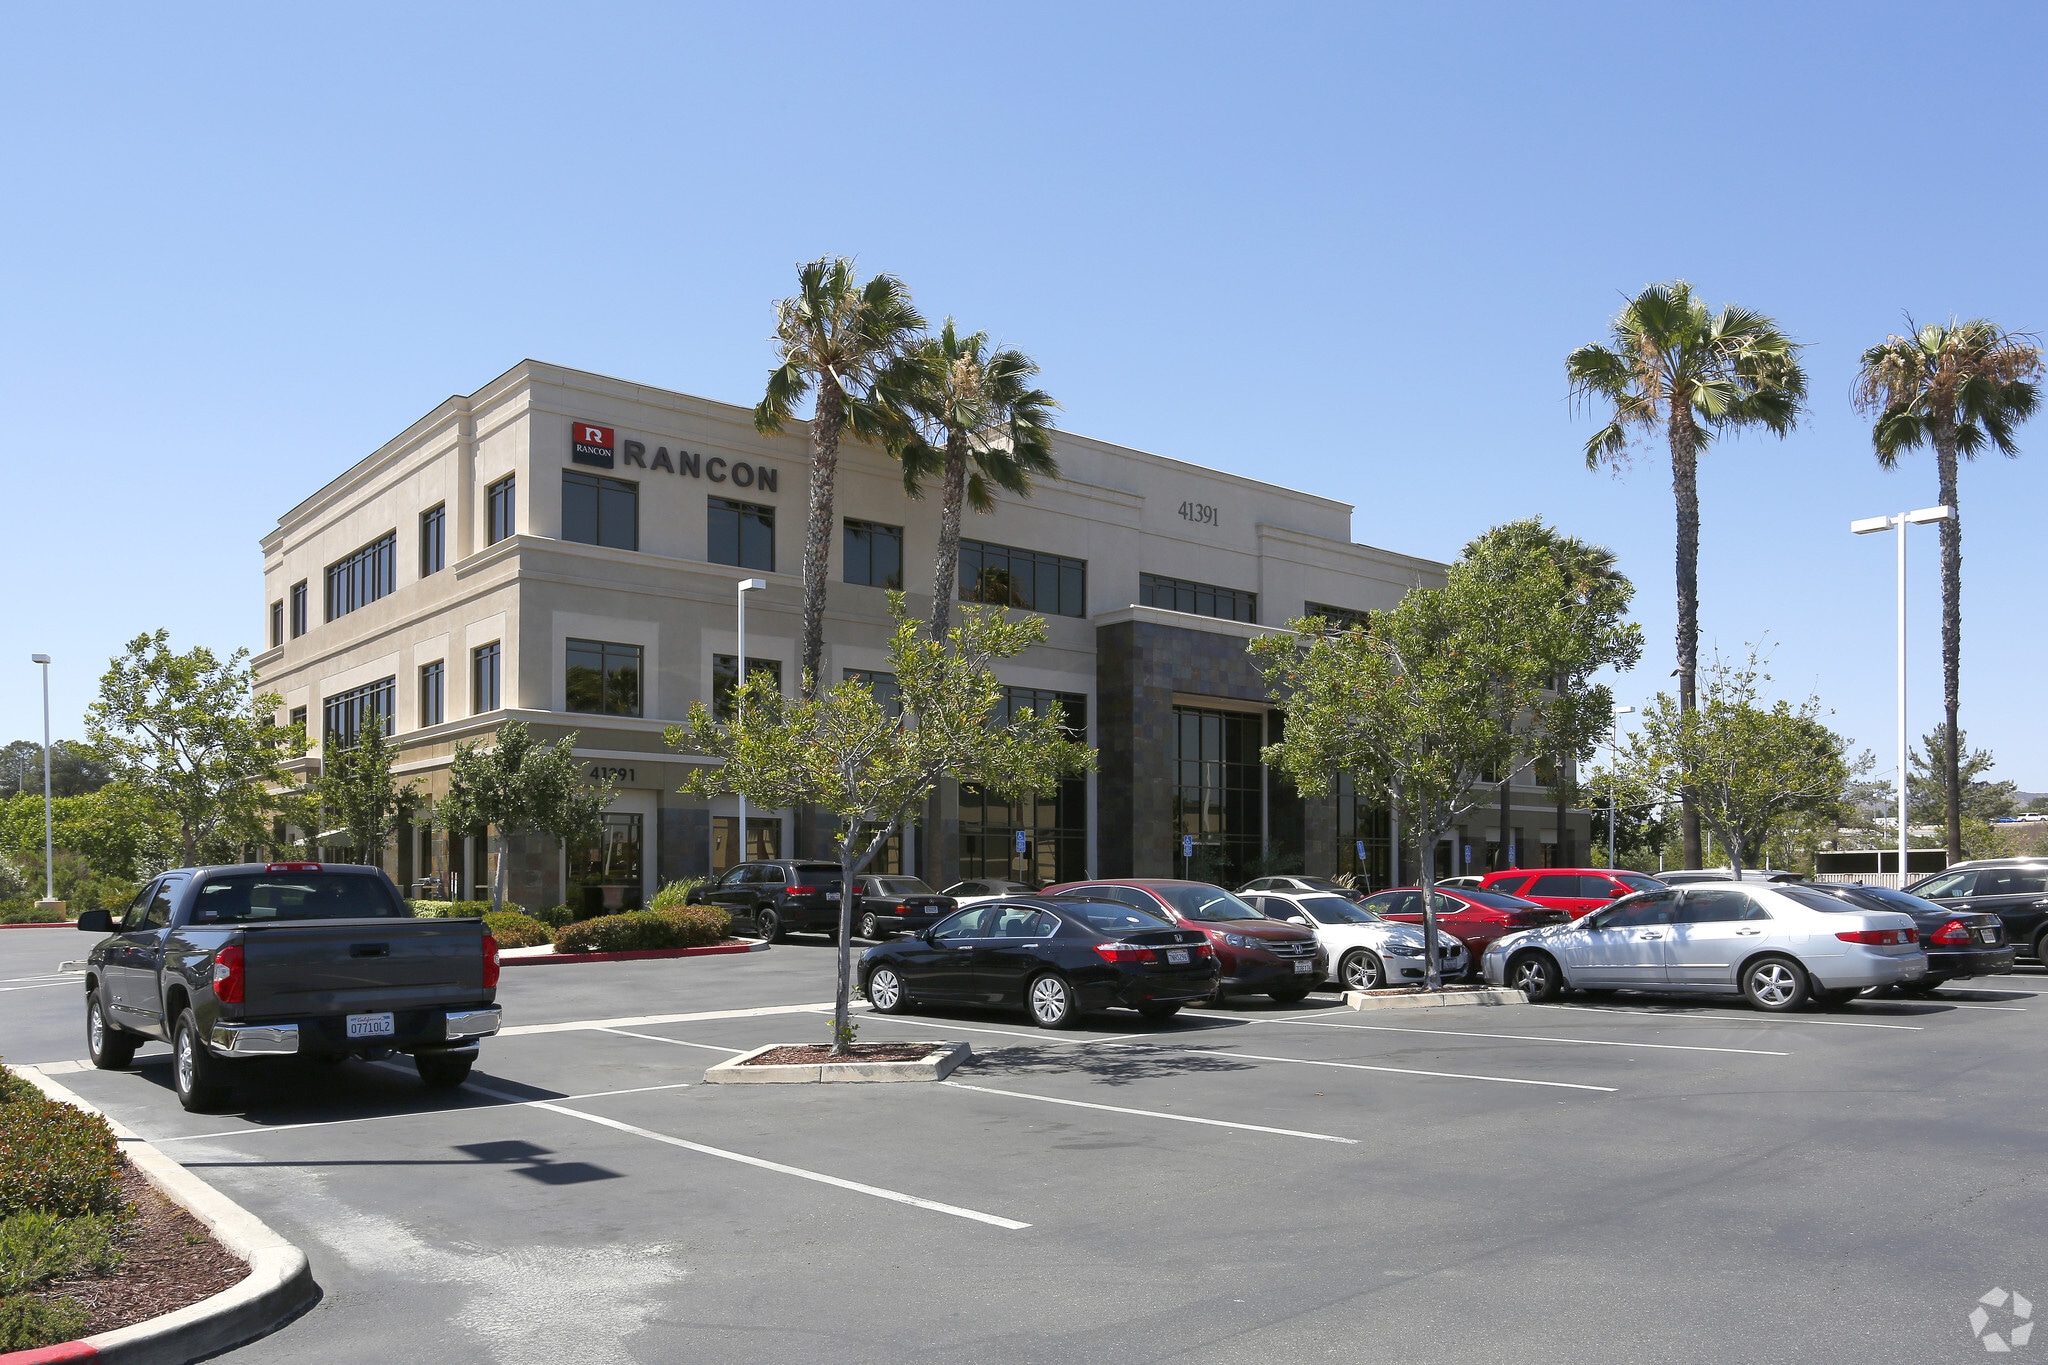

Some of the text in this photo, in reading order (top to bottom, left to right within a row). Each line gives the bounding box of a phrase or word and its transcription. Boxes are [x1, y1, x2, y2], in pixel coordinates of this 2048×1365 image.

[576, 444, 611, 457] RANCON
[624, 439, 778, 493] RANCON
[1178, 501, 1219, 527] 41391
[351, 1021, 390, 1034] 07710L2
